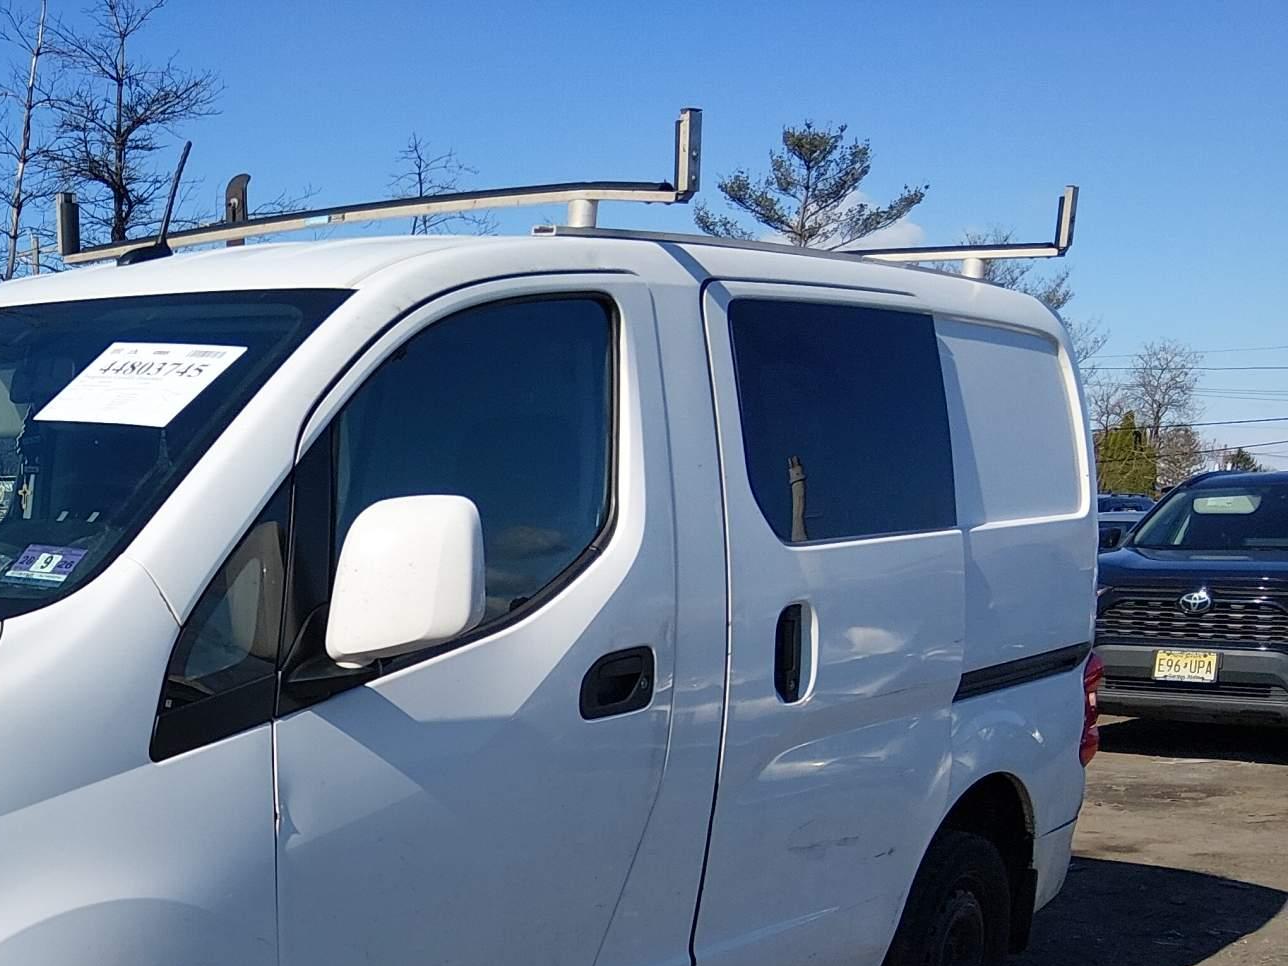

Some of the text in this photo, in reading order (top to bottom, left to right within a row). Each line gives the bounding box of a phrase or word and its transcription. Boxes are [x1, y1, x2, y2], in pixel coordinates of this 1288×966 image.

[99, 360, 210, 378] 44803745
[19, 555, 75, 570] 20 9 26
[1157, 658, 1213, 674] E96 UPA
